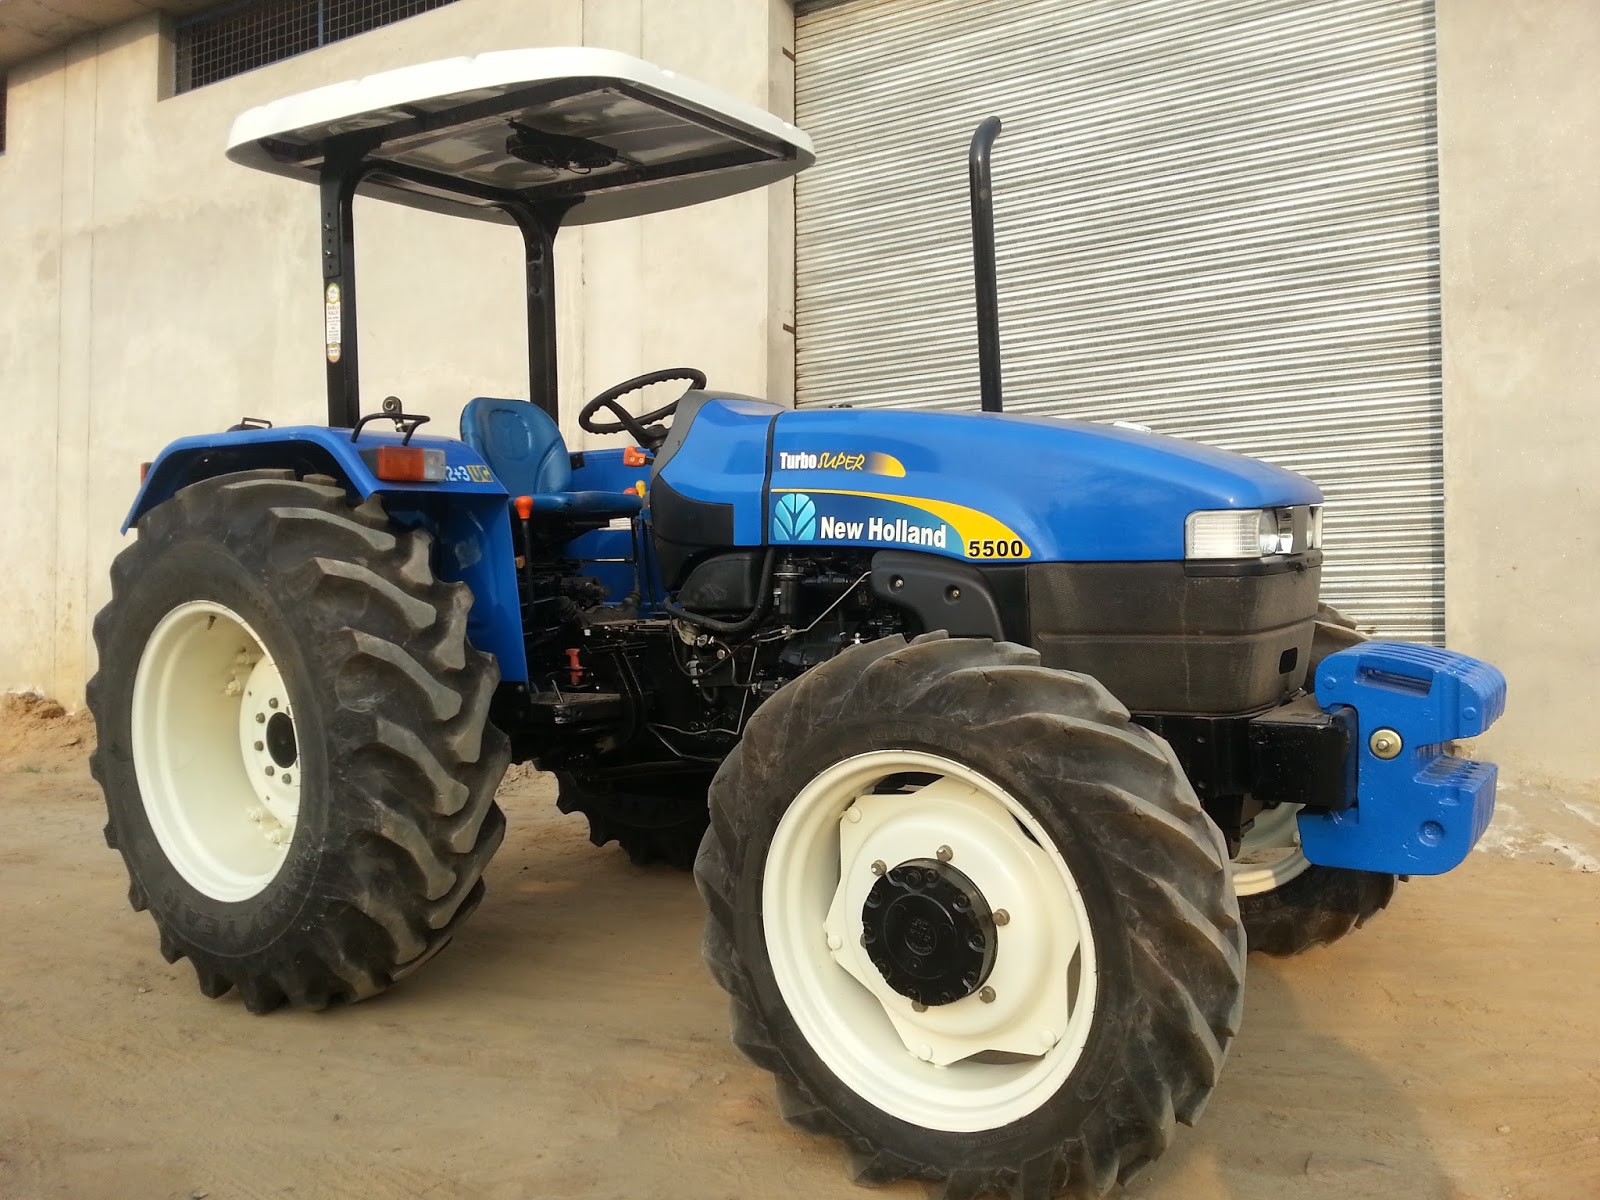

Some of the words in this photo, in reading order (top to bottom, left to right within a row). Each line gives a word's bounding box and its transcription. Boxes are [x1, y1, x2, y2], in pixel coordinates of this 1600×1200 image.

[780, 452, 817, 470] Turbo
[817, 452, 865, 471] SUPER
[445, 465, 471, 482] 2+3
[820, 516, 863, 539] New
[868, 517, 946, 549] Holland
[968, 539, 1023, 557] 5500
